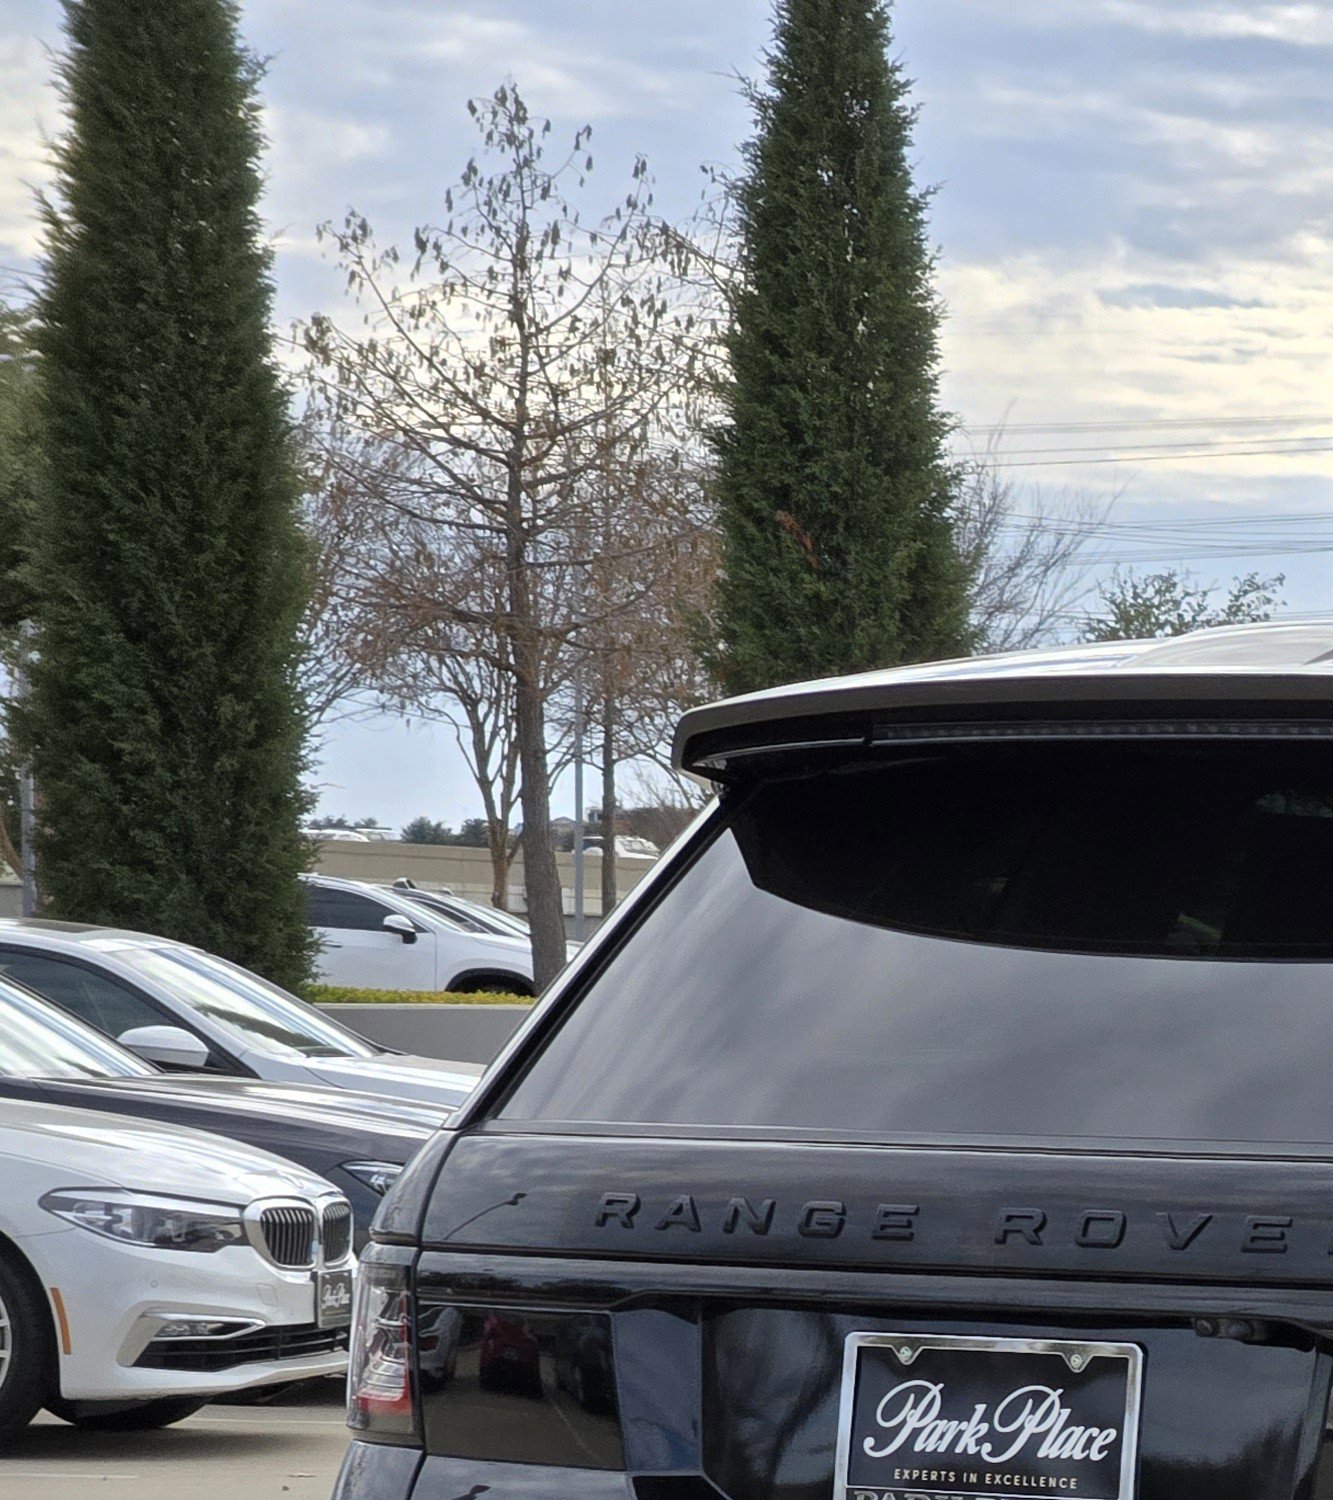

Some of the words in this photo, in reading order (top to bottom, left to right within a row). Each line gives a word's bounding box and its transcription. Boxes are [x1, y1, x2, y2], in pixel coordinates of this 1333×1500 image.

[595, 1192, 920, 1242] RANGE
[863, 1380, 988, 1457] Park
[981, 1385, 1117, 1464] Place
[894, 1469, 956, 1482] EXPERTS
[963, 1472, 978, 1484] IN
[985, 1473, 1078, 1489] EXCELLENCE
